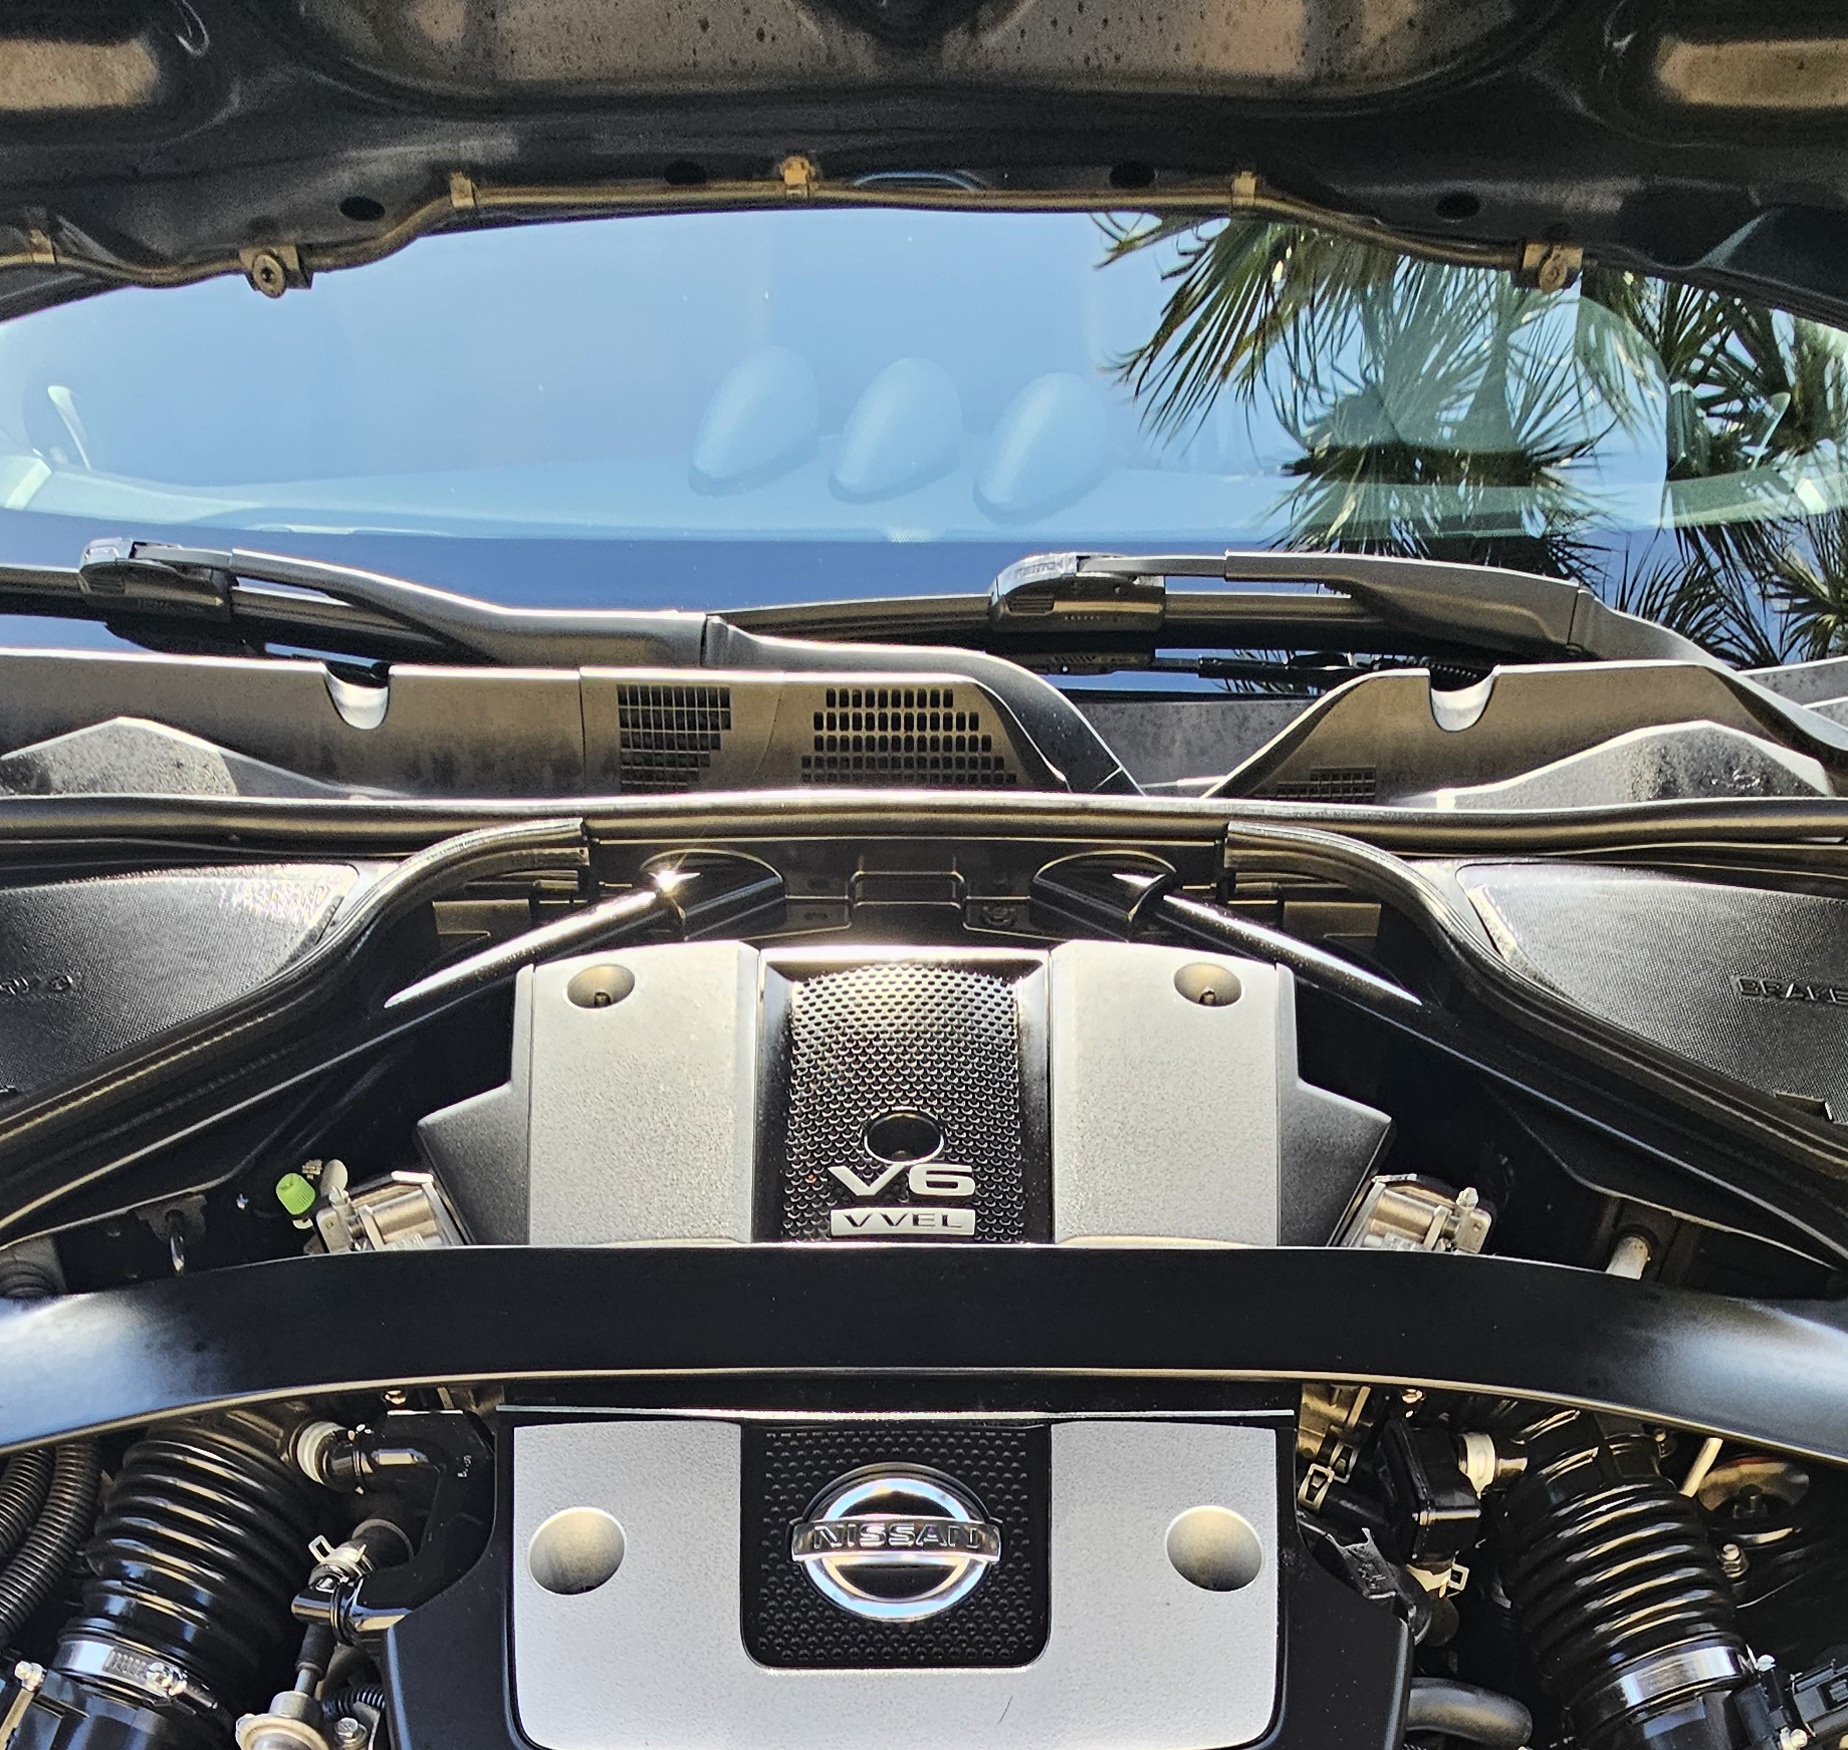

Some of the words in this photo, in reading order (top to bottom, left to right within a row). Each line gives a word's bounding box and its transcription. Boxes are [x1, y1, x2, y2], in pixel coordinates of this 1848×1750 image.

[828, 1163, 976, 1197] V6
[843, 1212, 963, 1228] VVEL
[814, 1523, 981, 1550] NISSAN
